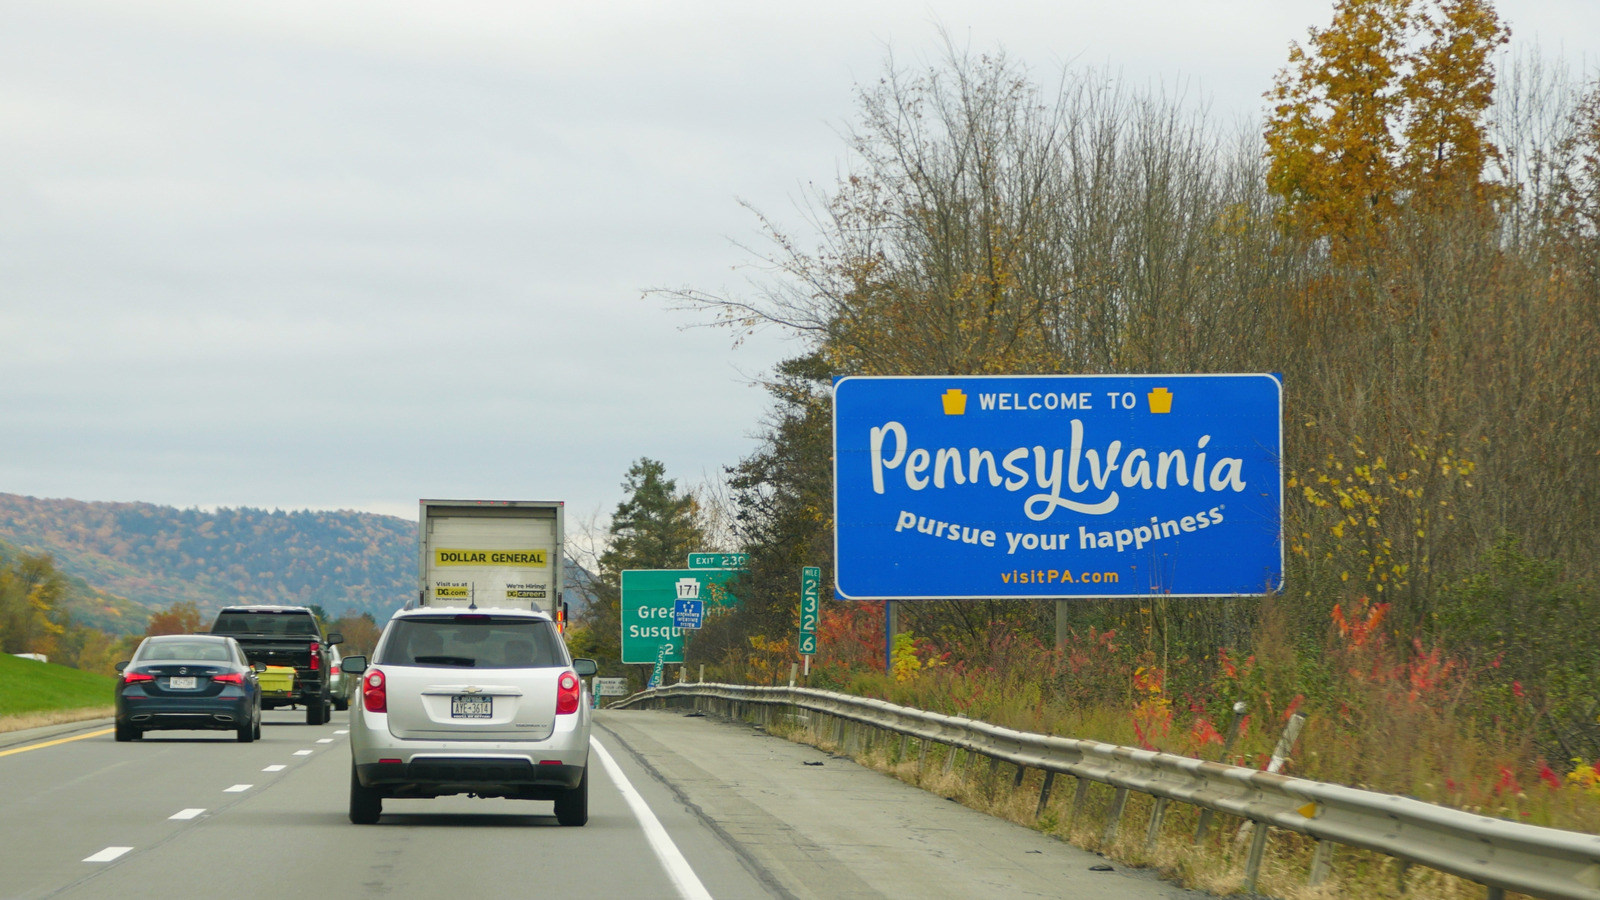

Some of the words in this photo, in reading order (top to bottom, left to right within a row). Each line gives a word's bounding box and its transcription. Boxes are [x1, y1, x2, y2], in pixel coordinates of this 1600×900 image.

[979, 393, 1093, 410] WELCOME
[1107, 392, 1137, 409] TO
[870, 419, 1247, 521] Pennsylvania
[895, 510, 996, 548] pursue
[1006, 530, 1070, 554] your
[441, 552, 486, 563] DOLLAR
[491, 553, 543, 563] GENERAL
[696, 557, 715, 565] EXIT
[804, 569, 818, 577] MILE
[1001, 569, 1119, 584] visitPA.com
[679, 584, 699, 596] 171
[664, 643, 674, 655] 2
